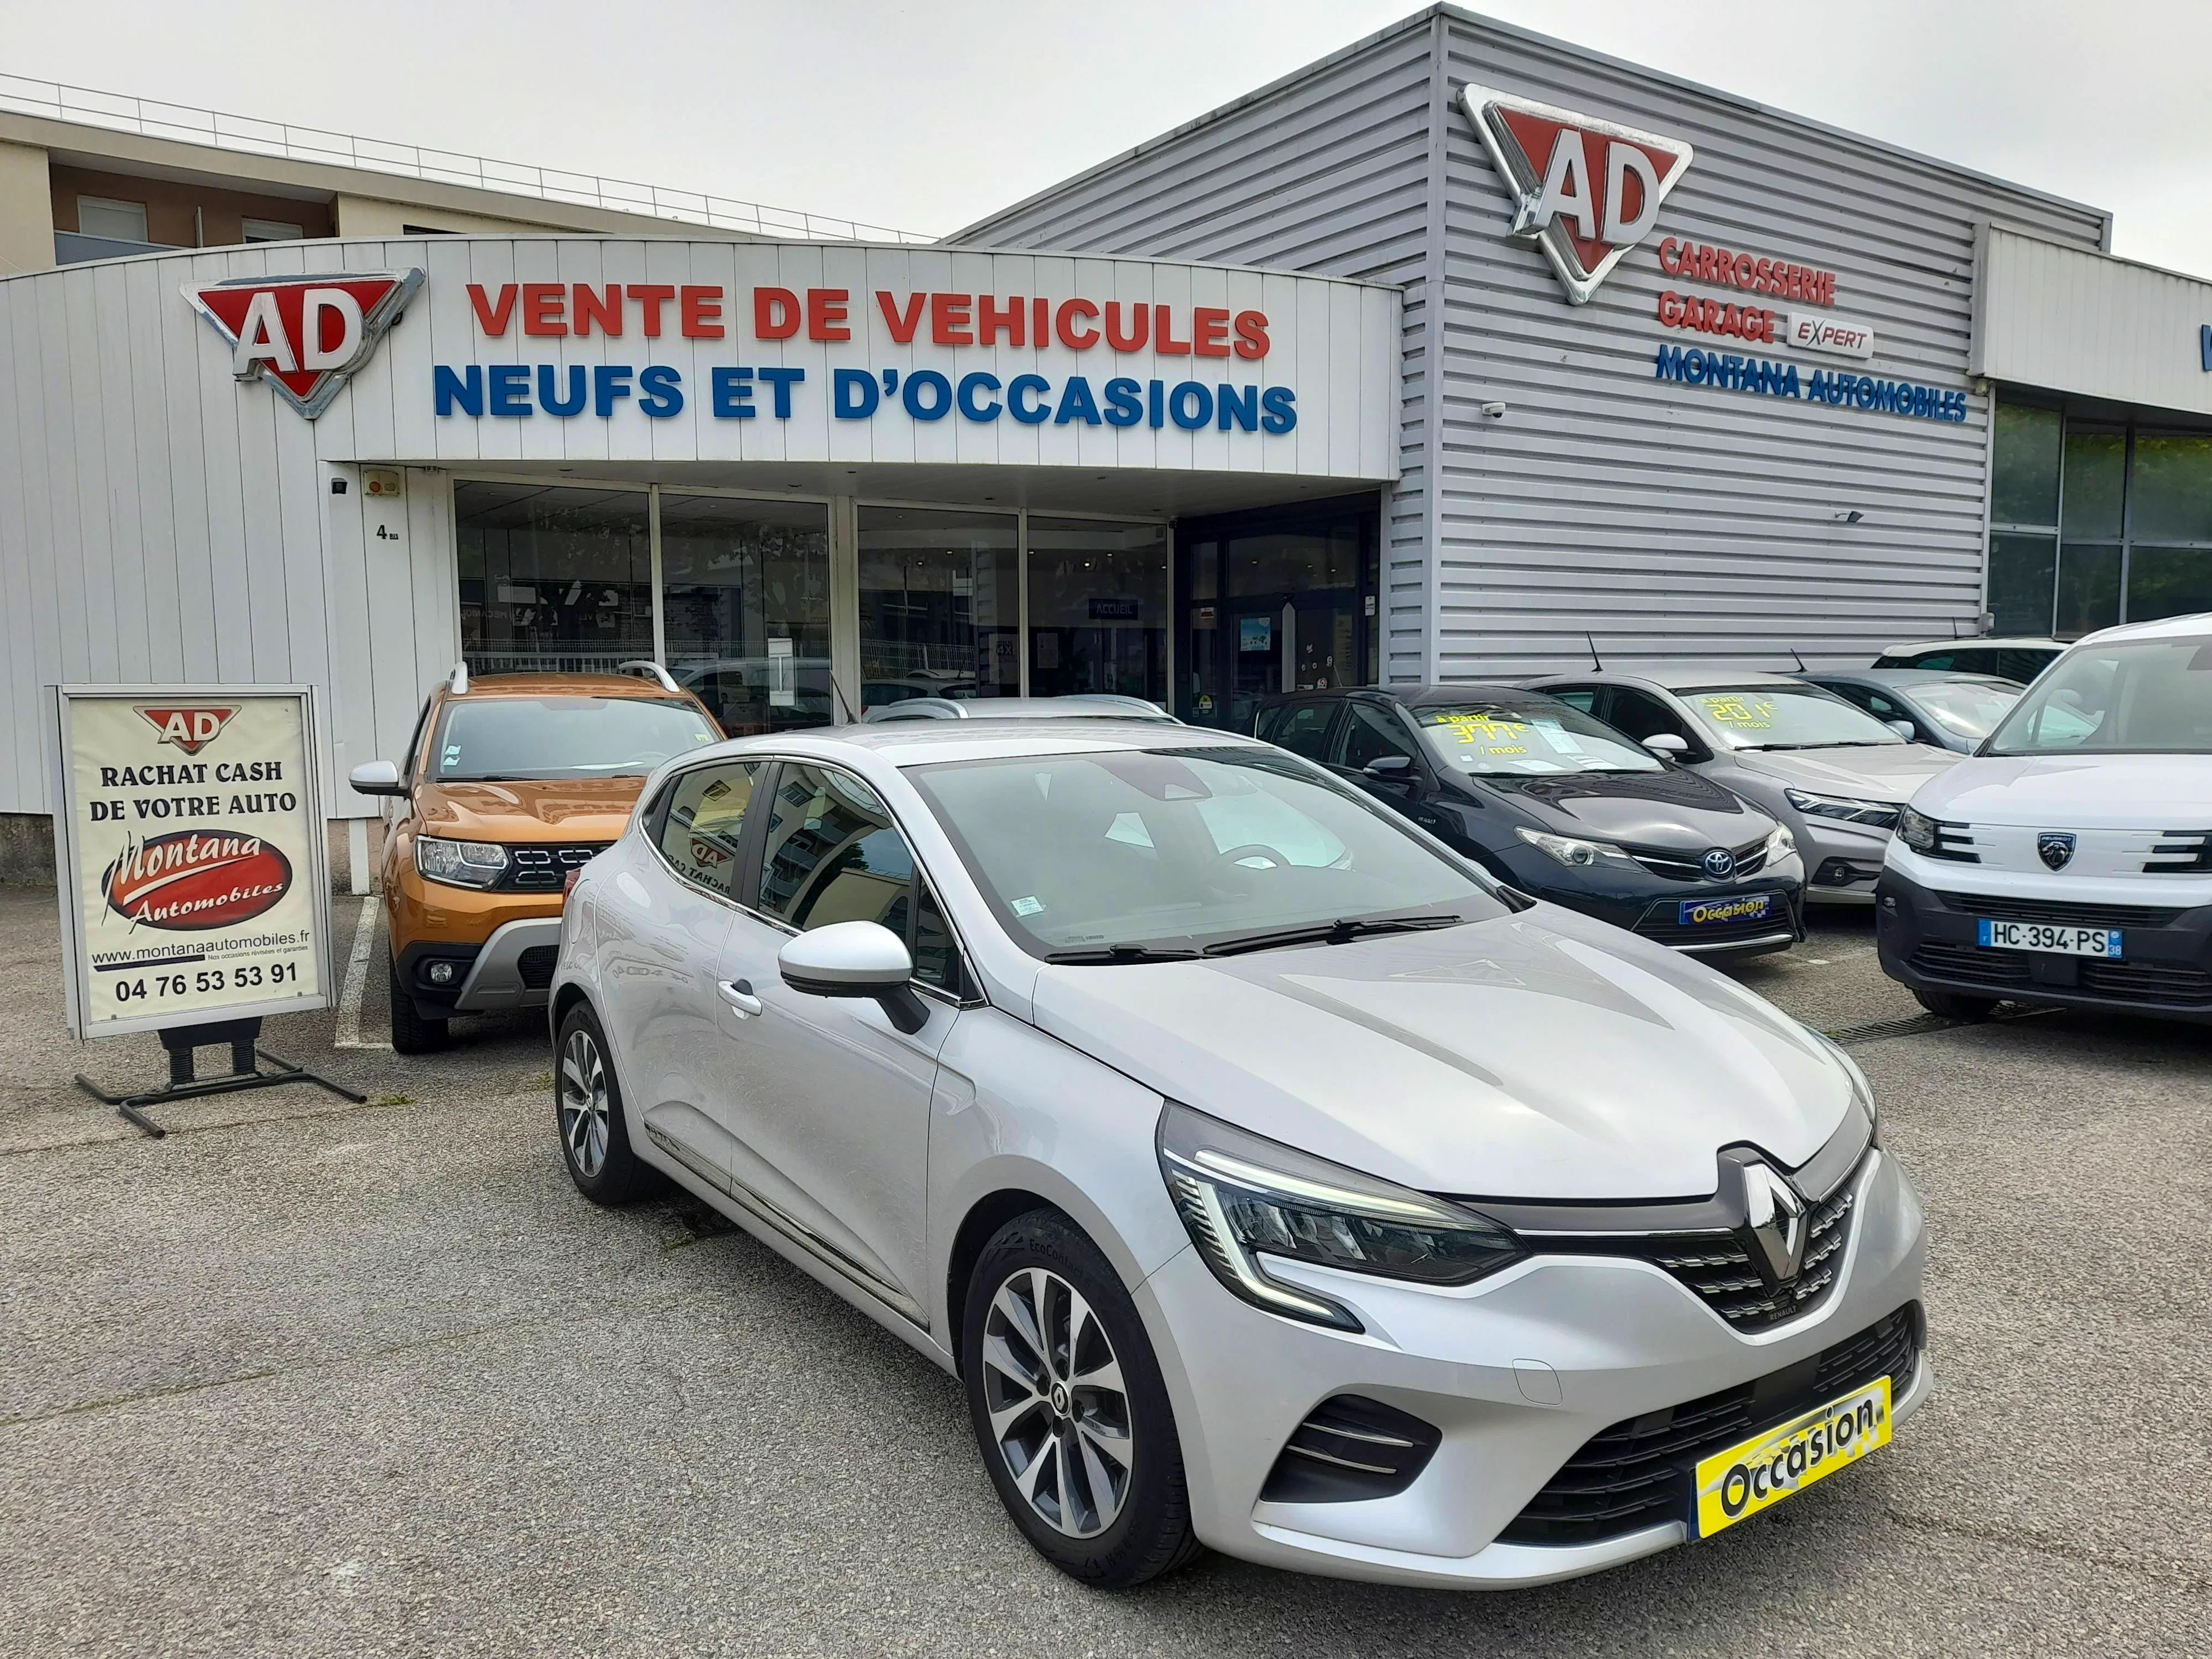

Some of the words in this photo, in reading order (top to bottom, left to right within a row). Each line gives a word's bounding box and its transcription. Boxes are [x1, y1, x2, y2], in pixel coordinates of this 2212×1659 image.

[1532, 128, 1660, 245] AD
[1660, 237, 1836, 307] CARROSSERIE
[232, 287, 364, 376] AD
[465, 283, 725, 339] VENTE
[754, 287, 851, 340] DE
[875, 291, 1271, 360] VEHICULES
[1658, 290, 1775, 343] GARAGE
[1798, 320, 1867, 349] EXPERT
[434, 365, 684, 418] NEUFS
[711, 367, 805, 418] ET
[834, 369, 1297, 434] D'OCCASIONS
[1656, 344, 1801, 398] MONTANA
[1808, 369, 1967, 423] AUTOMOBILES
[376, 524, 387, 539] 4
[1097, 603, 1132, 615] ACCUEIL
[1709, 695, 1744, 703] partir
[159, 711, 220, 743] AD
[1448, 714, 1490, 724] partir
[1488, 745, 1527, 755] mois
[100, 764, 208, 787] RACHAT
[215, 762, 282, 782] CASH
[89, 800, 125, 821] DE
[133, 796, 220, 819] VOTRE
[228, 793, 297, 814] AUTO
[101, 831, 262, 927] Montana
[128, 882, 283, 934] Automobiles
[1693, 897, 1765, 923] Occasion
[92, 930, 310, 963] www.montanaautomobiles.fr
[1994, 923, 2105, 953] HC-394-PS
[2109, 945, 2122, 956] 38
[116, 979, 147, 1002] 04
[156, 975, 186, 997] 76
[196, 970, 225, 992] 53
[234, 966, 262, 988] 53
[271, 962, 297, 983] 91
[1029, 1238, 1083, 1278] EcoContact
[1770, 1305, 1797, 1321] RENAULT
[1721, 1398, 1874, 1520] Occasion
